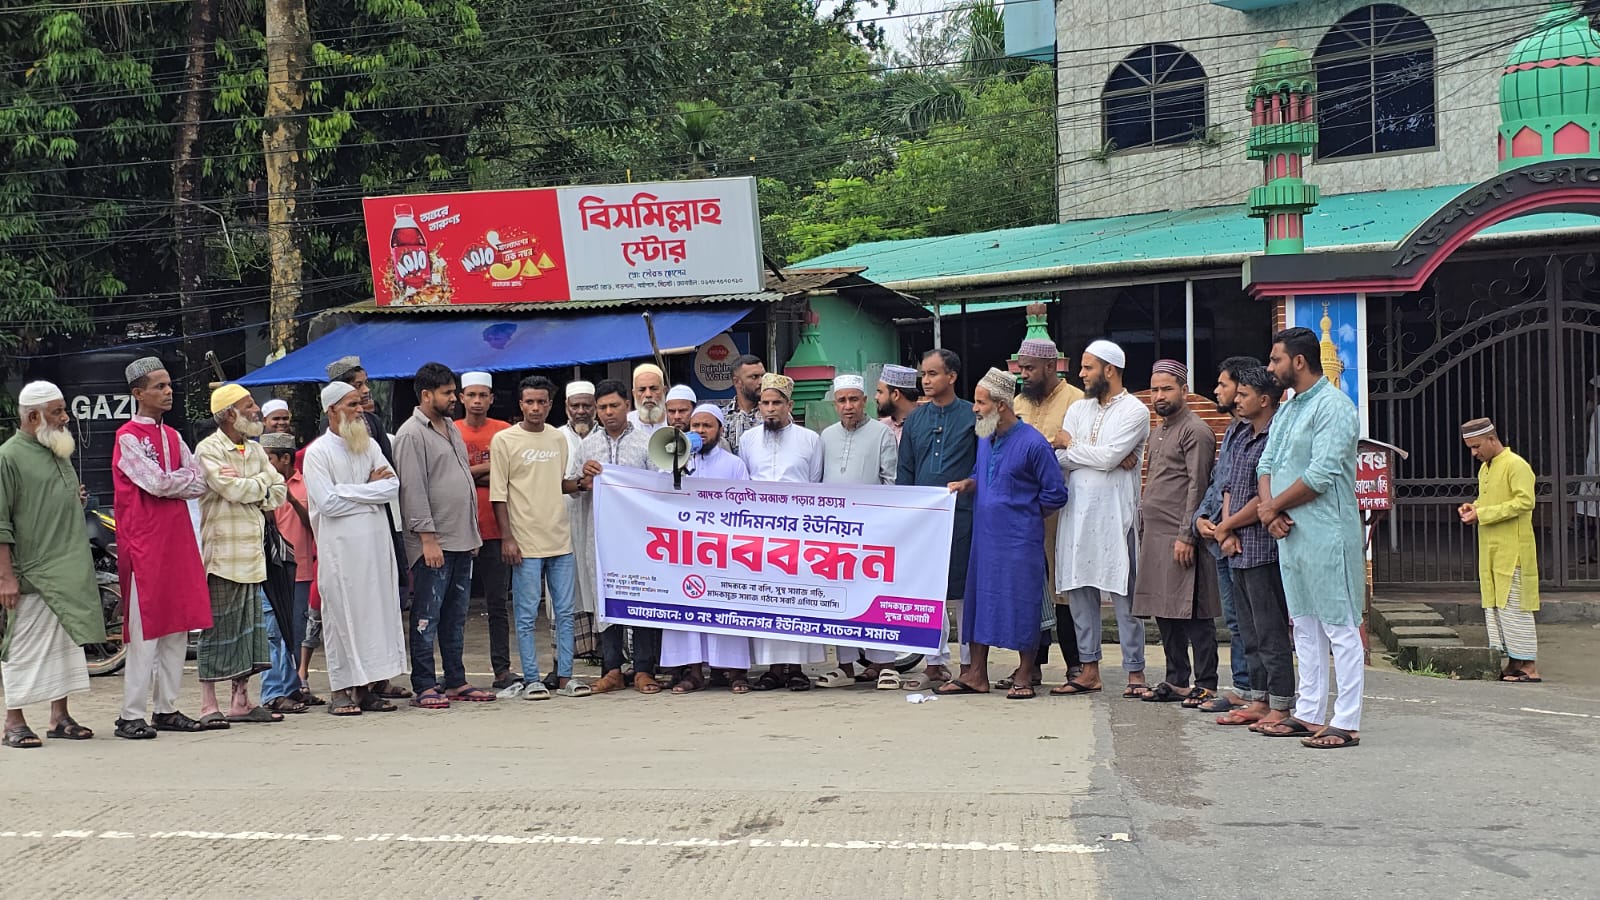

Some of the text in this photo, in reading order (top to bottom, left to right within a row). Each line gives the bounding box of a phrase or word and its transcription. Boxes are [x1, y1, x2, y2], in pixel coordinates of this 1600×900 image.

[578, 192, 722, 233] বিসমিল্লাহ
[461, 247, 494, 272] MOJO
[621, 236, 687, 267] স্টোর
[700, 363, 733, 374] Drinkin
[725, 487, 756, 504] বিরোধী
[758, 493, 788, 505] সমাজ
[818, 496, 846, 508] প্রত্যয়
[677, 509, 864, 537] ৩ নং খাদিমনগর ইউনিয়ন
[645, 526, 896, 583] মানববন্ধন
[738, 592, 758, 602] সমাজ
[760, 593, 778, 603] গঠনে
[748, 583, 756, 591] না
[757, 583, 773, 594] বলি,
[787, 587, 808, 596] সমাজ
[903, 613, 930, 623] আগামী
[914, 604, 936, 613] সমাজ
[684, 611, 695, 622] ৩
[697, 611, 712, 624] নং
[714, 611, 772, 631] খাদিমনগর
[775, 616, 819, 635] ইউনিয়ন
[822, 623, 861, 638] সচেতন
[864, 627, 900, 641] সমাজ
